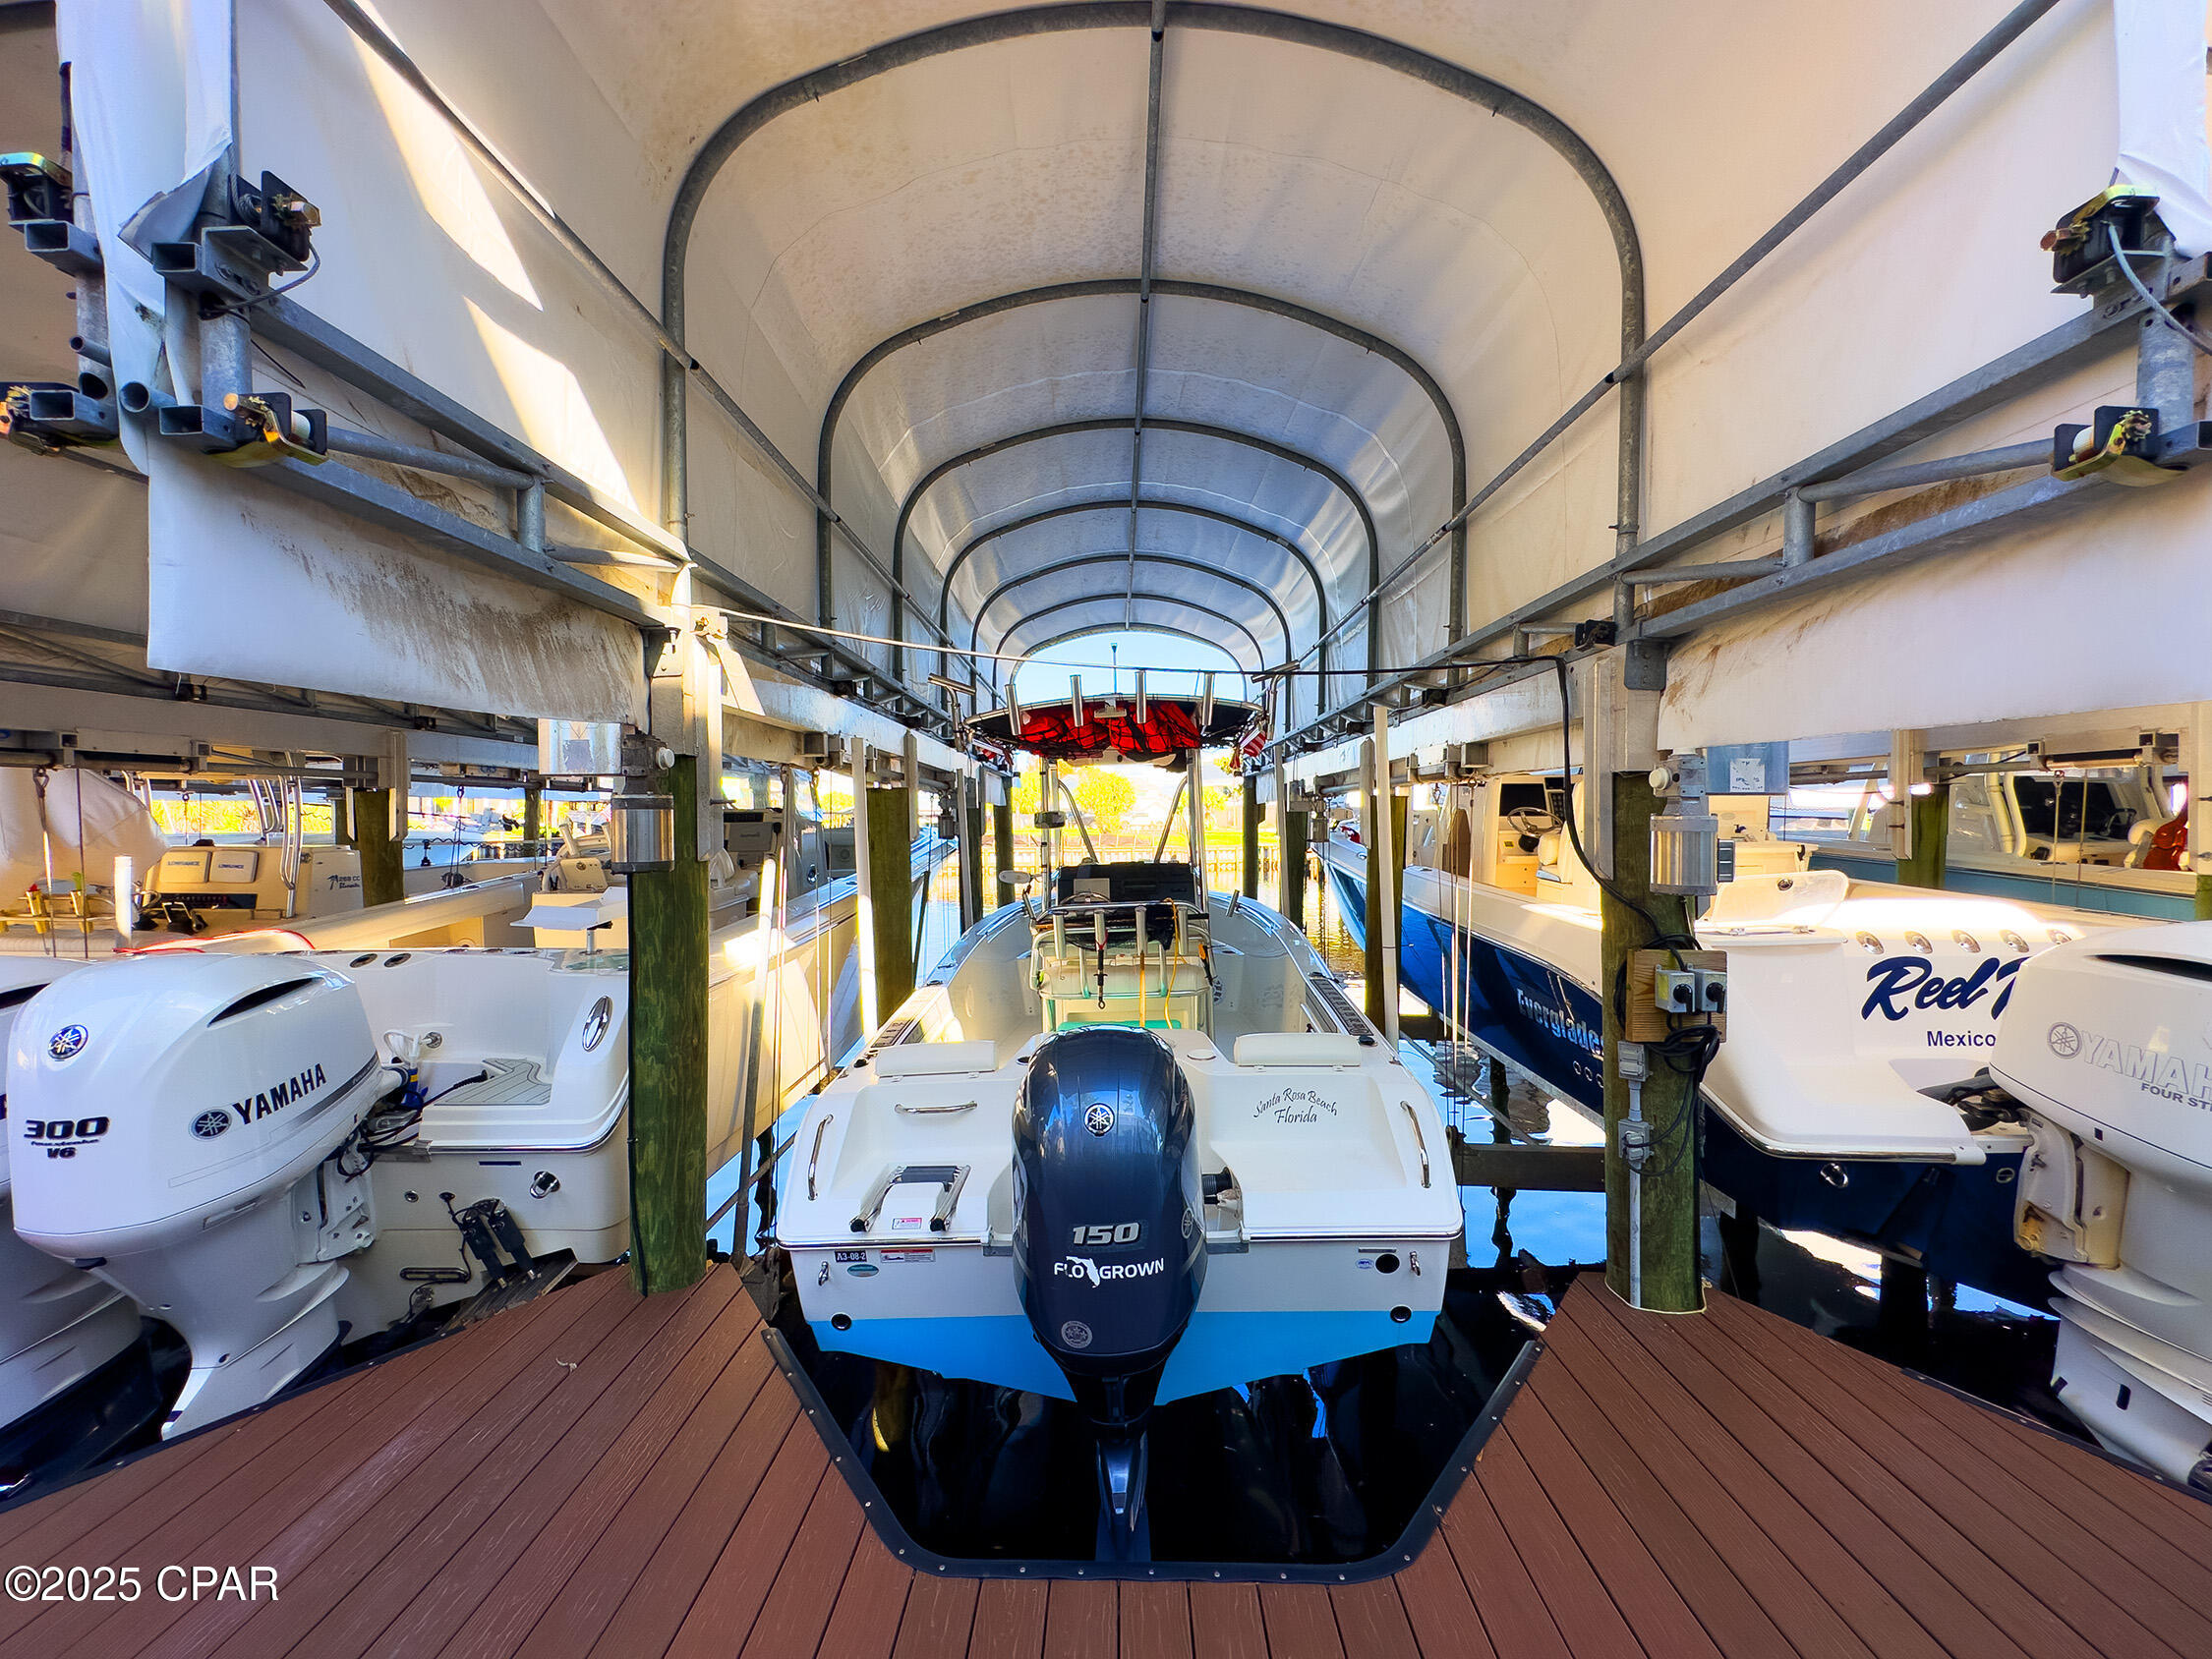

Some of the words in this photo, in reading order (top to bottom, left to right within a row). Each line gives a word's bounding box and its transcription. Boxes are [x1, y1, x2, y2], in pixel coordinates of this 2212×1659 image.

[1861, 956, 1980, 1021] Reel
[1927, 1031, 1997, 1047] Mexico
[232, 1063, 327, 1125] YAMAHA
[1253, 1093, 1281, 1117] Santa
[1283, 1087, 1306, 1102] Rosa
[1308, 1090, 1337, 1116] Beach
[2141, 1082, 2183, 1104] FOUR
[1274, 1105, 1317, 1123] Florida
[24, 1116, 109, 1139] 300
[47, 1147, 77, 1159] V6
[1073, 1222, 1141, 1245] 150
